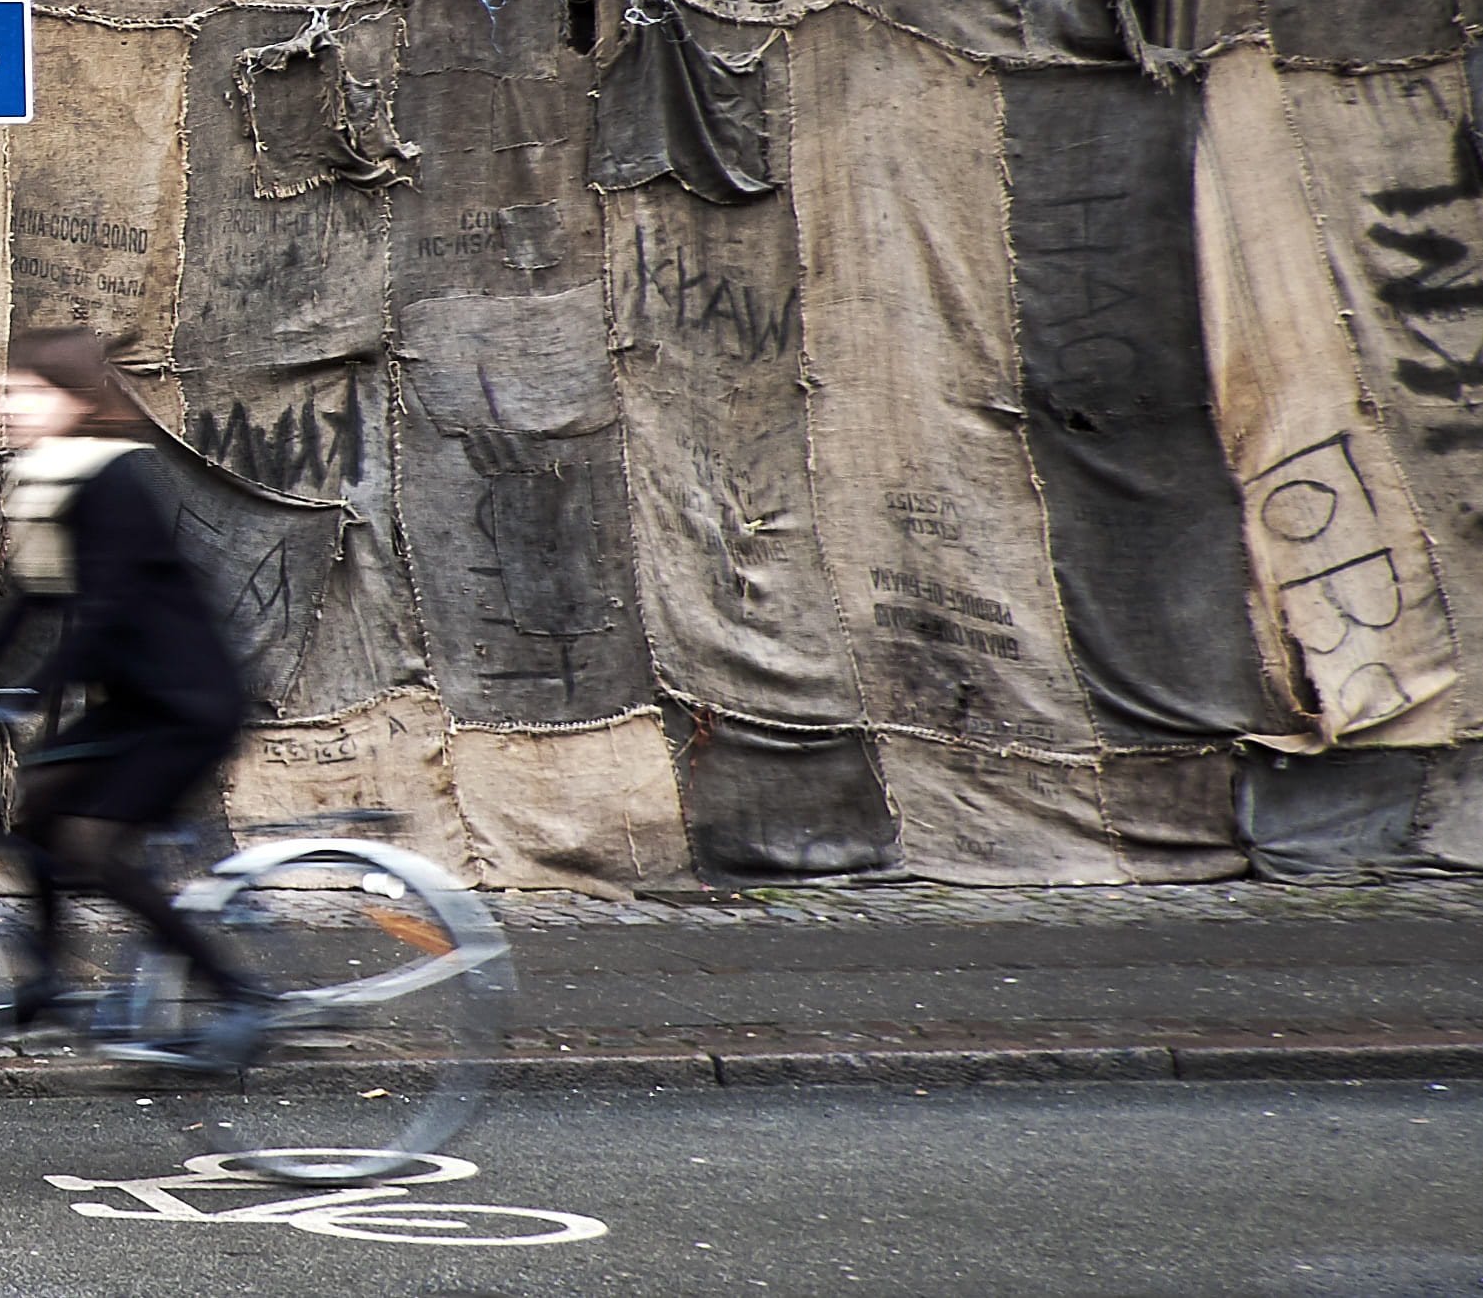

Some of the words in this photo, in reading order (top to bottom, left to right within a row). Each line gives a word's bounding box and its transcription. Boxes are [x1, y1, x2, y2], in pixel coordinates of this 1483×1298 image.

[51, 212, 96, 244] COCOA
[100, 221, 148, 254] BOARD
[96, 273, 147, 298] GHANA
